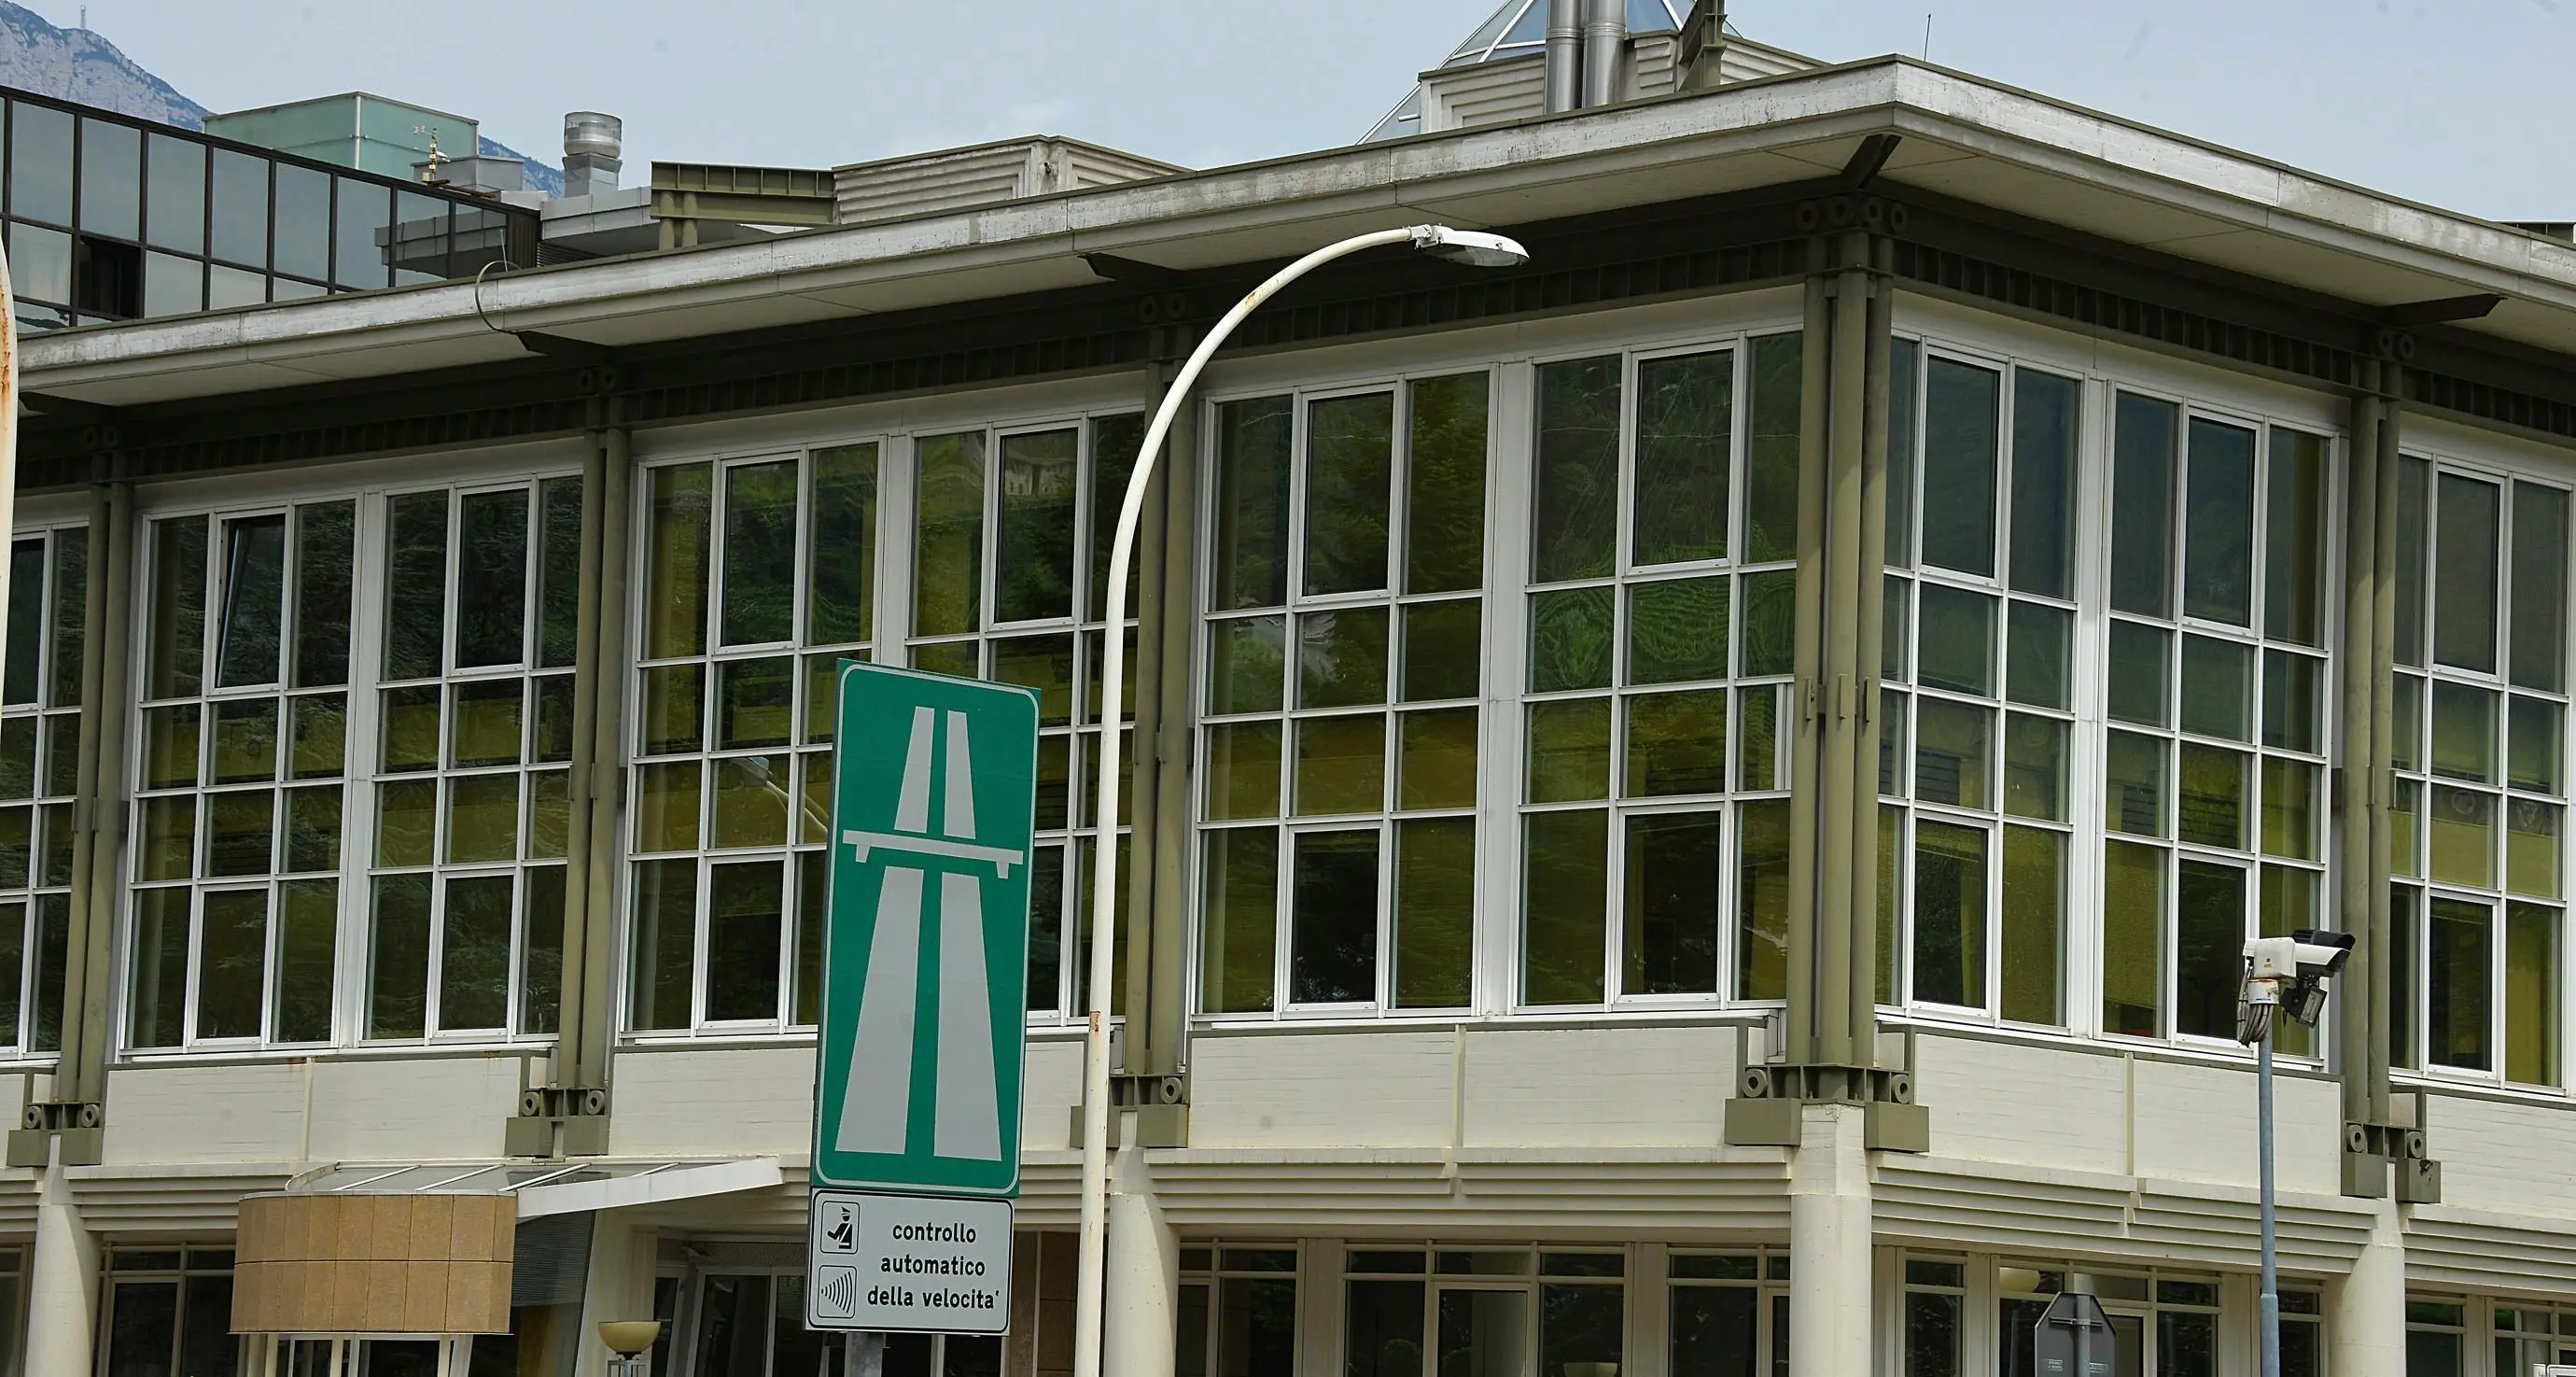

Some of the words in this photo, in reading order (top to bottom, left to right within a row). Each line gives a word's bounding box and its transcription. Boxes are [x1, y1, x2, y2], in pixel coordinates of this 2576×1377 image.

[892, 1221, 976, 1244] controllo
[880, 1254, 986, 1276] automatico
[867, 1285, 914, 1307] della
